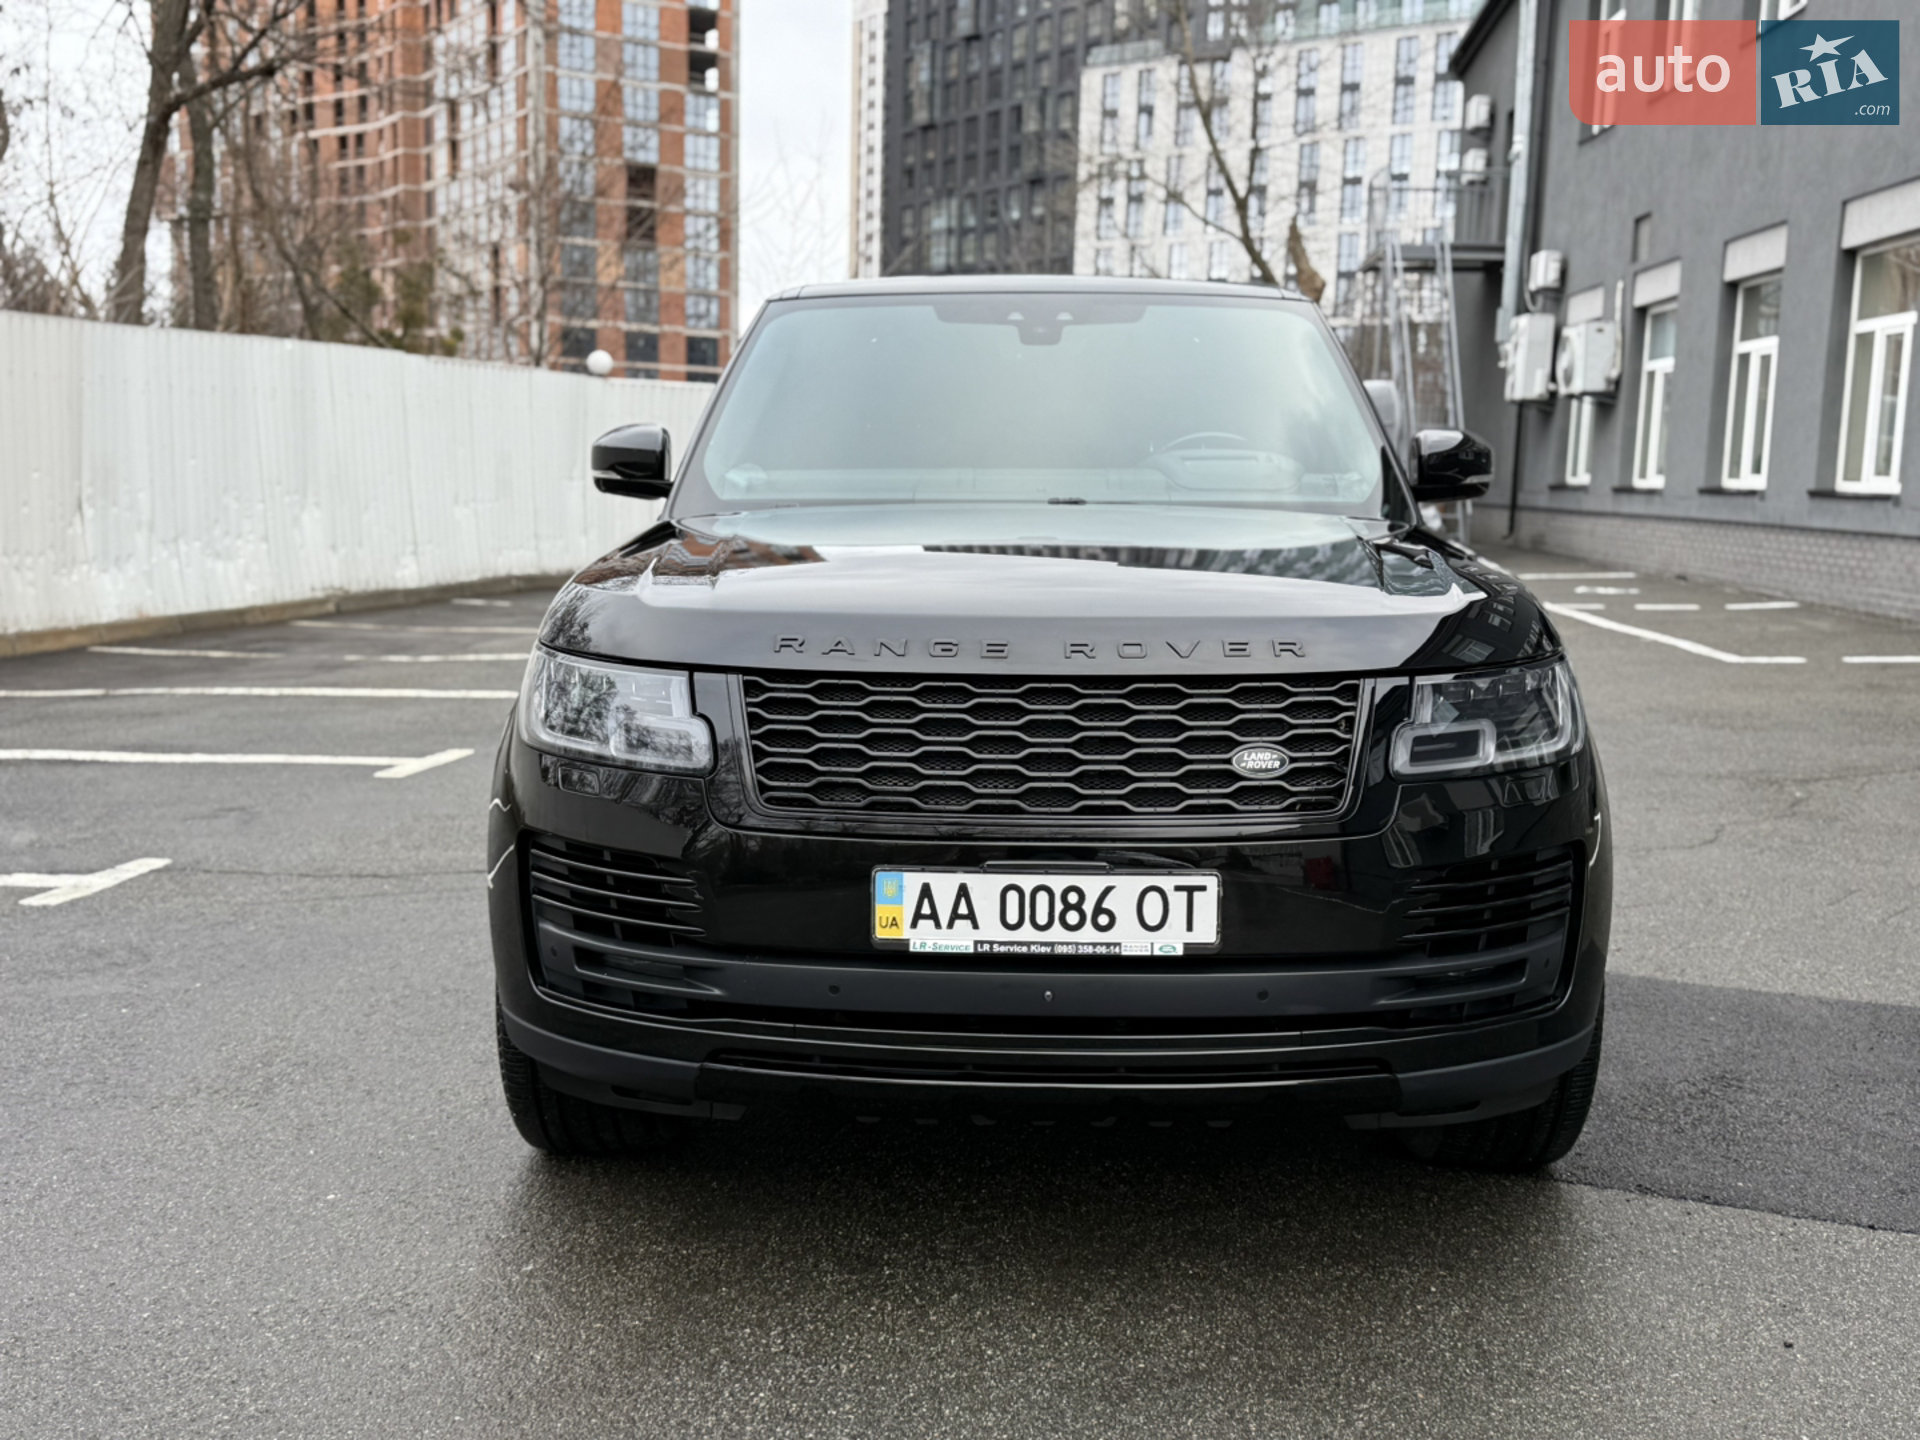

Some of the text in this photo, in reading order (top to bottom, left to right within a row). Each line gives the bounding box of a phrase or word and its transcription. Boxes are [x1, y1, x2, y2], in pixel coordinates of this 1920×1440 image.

[774, 634, 1306, 659] RANGE ROVER
[1243, 752, 1271, 761] LAND
[1246, 760, 1281, 769] ROVER
[909, 882, 1208, 933] AA 0086 OT
[878, 915, 900, 930] UA
[977, 943, 990, 952] LR
[992, 943, 1028, 953] Service
[1030, 944, 1052, 953] Kiev
